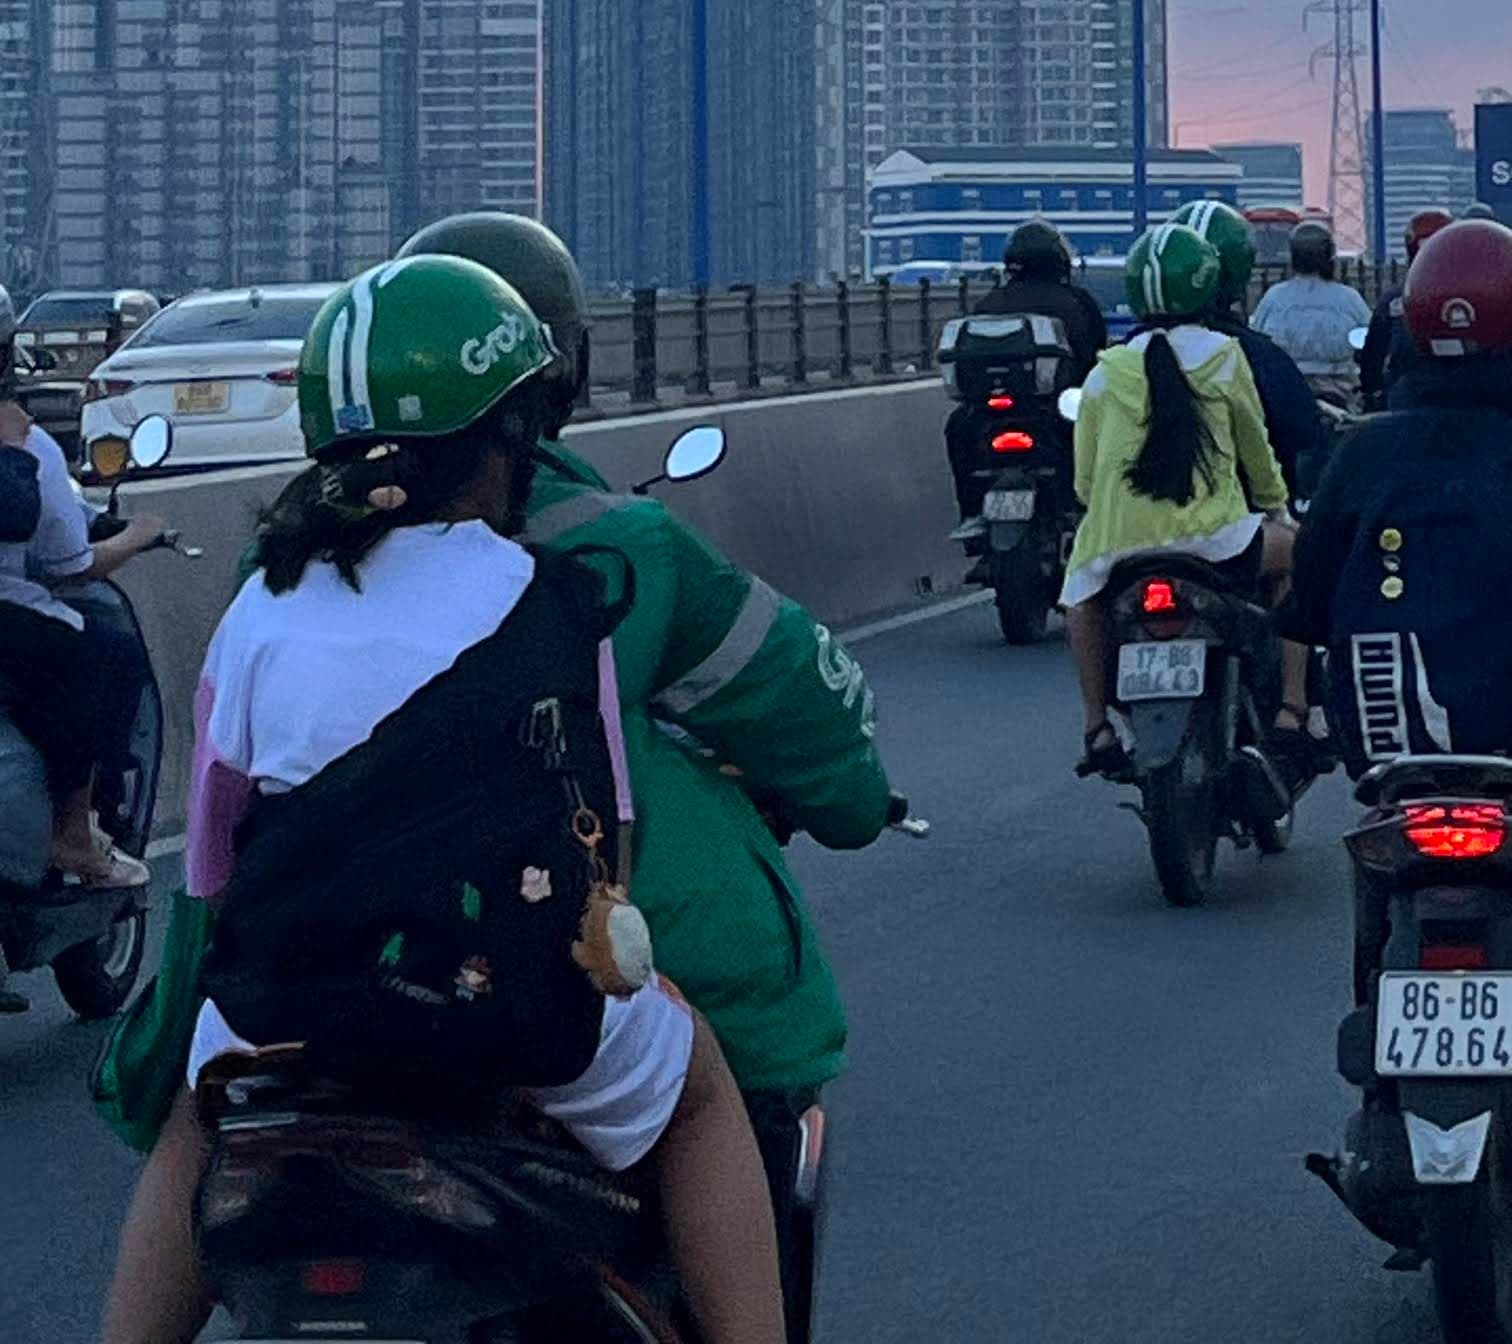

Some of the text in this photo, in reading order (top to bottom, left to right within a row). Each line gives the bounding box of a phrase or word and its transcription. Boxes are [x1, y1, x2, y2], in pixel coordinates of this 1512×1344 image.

[1354, 636, 1407, 757] PUMA
[1402, 981, 1498, 1021] 86-B6
[1386, 1025, 1511, 1068] 478.64
